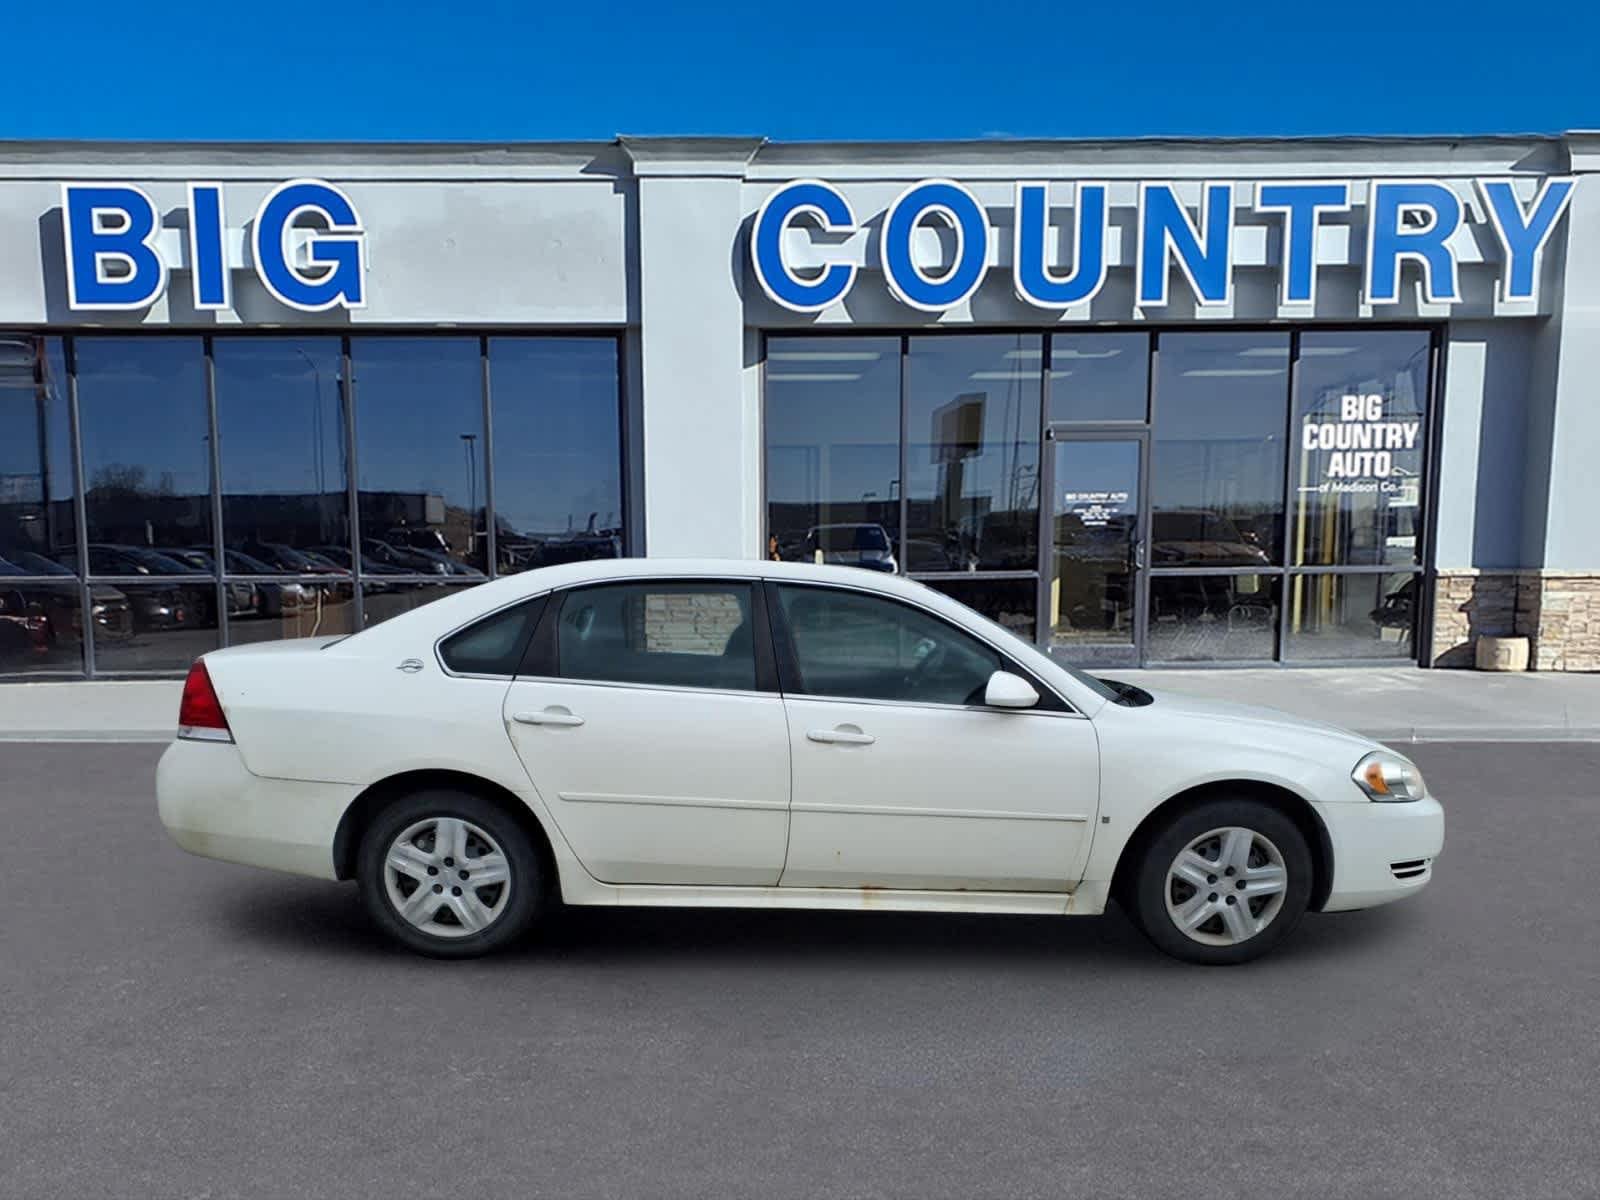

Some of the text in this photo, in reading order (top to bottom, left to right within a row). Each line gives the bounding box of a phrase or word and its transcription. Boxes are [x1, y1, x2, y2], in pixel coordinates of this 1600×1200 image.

[61, 176, 1575, 312] BIG COUNTRY
[1341, 394, 1382, 421] BIG
[1303, 422, 1419, 450] COUNTRY
[1327, 451, 1391, 478] AUTO
[1319, 482, 1329, 493] of
[1331, 481, 1378, 492] Madison
